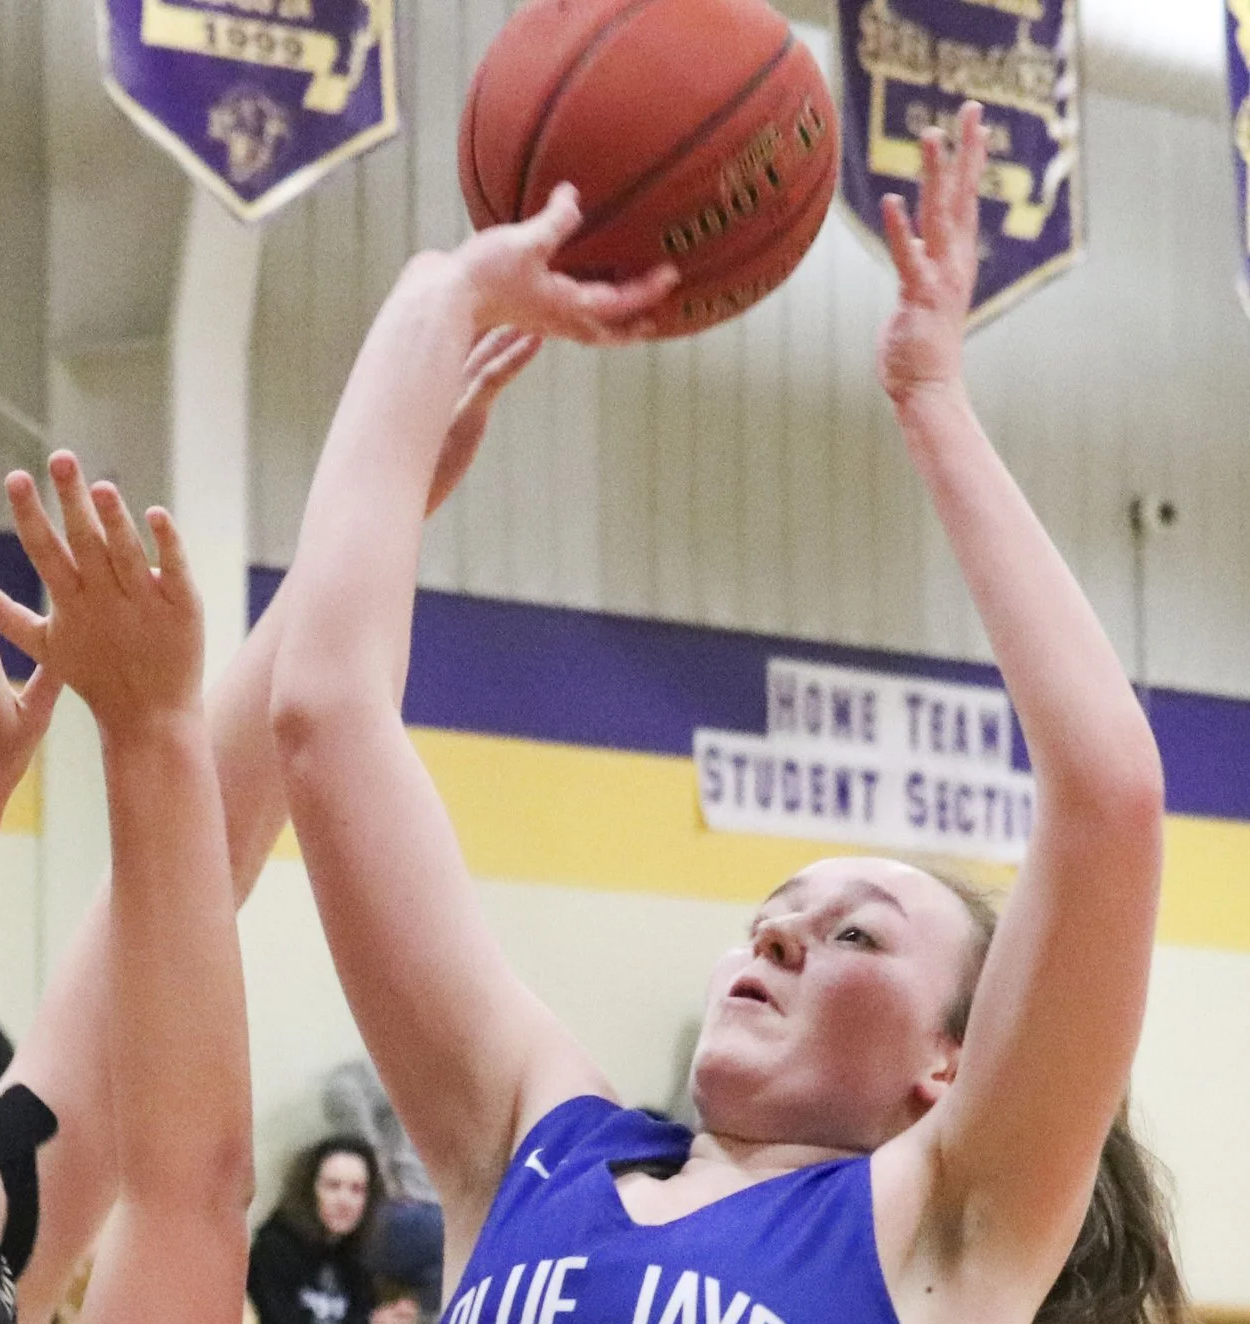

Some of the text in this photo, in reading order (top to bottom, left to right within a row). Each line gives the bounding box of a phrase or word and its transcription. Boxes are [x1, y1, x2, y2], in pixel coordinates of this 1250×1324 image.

[769, 669, 1000, 757] HOME TEAM
[704, 743, 878, 822] STUDENT
